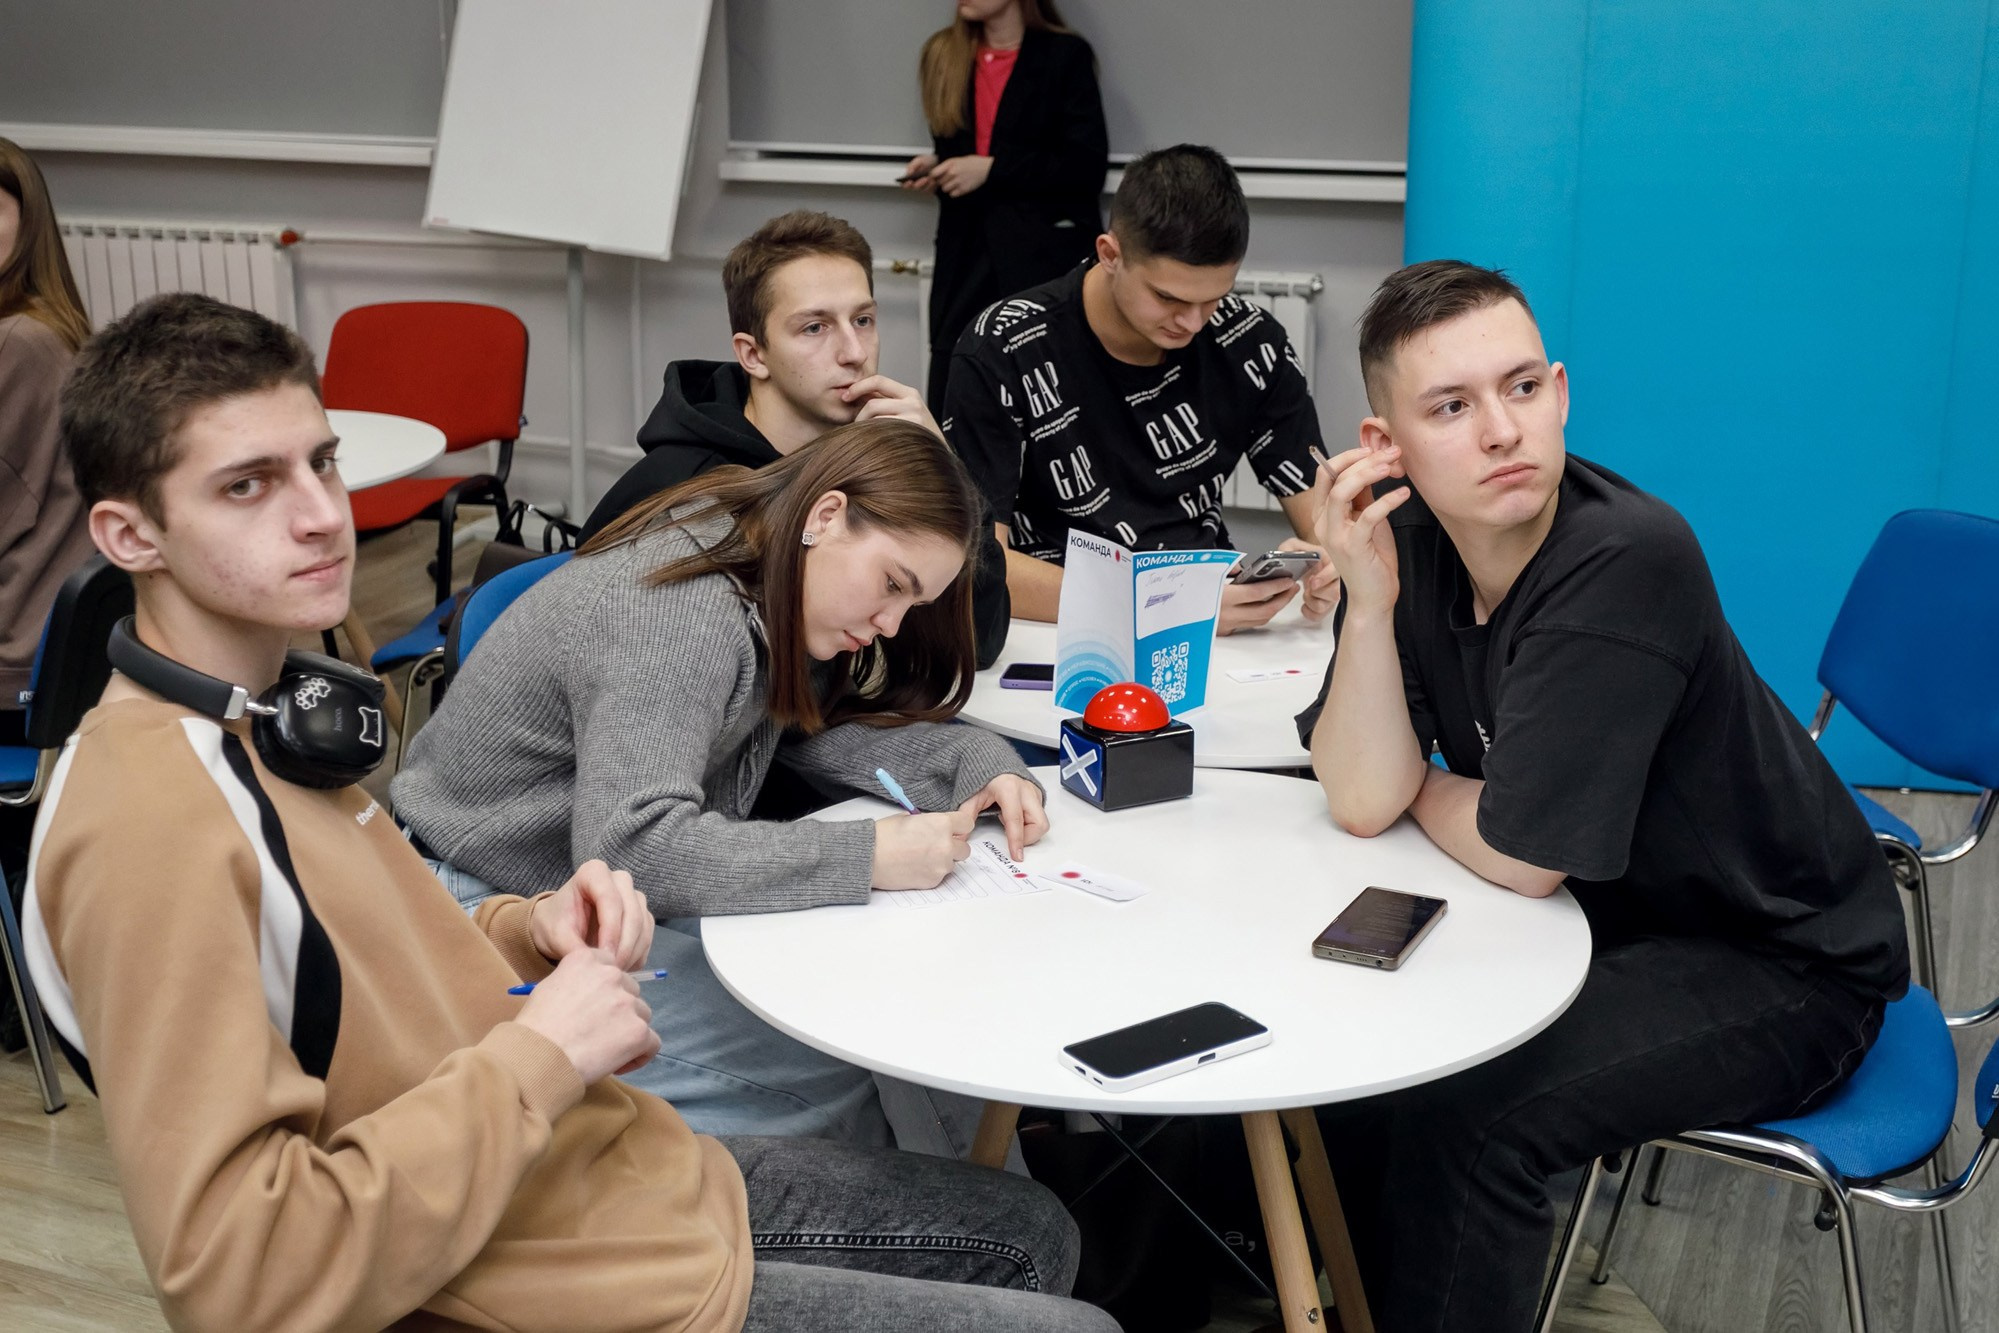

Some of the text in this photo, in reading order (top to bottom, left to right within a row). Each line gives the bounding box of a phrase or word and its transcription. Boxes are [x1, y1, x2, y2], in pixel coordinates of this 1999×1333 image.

[1022, 361, 1063, 418] GAP
[1145, 402, 1204, 460] GAP
[1049, 445, 1096, 500] GAP
[1070, 536, 1112, 558] КОМАНДА
[1136, 554, 1194, 569] КОМАНДА
